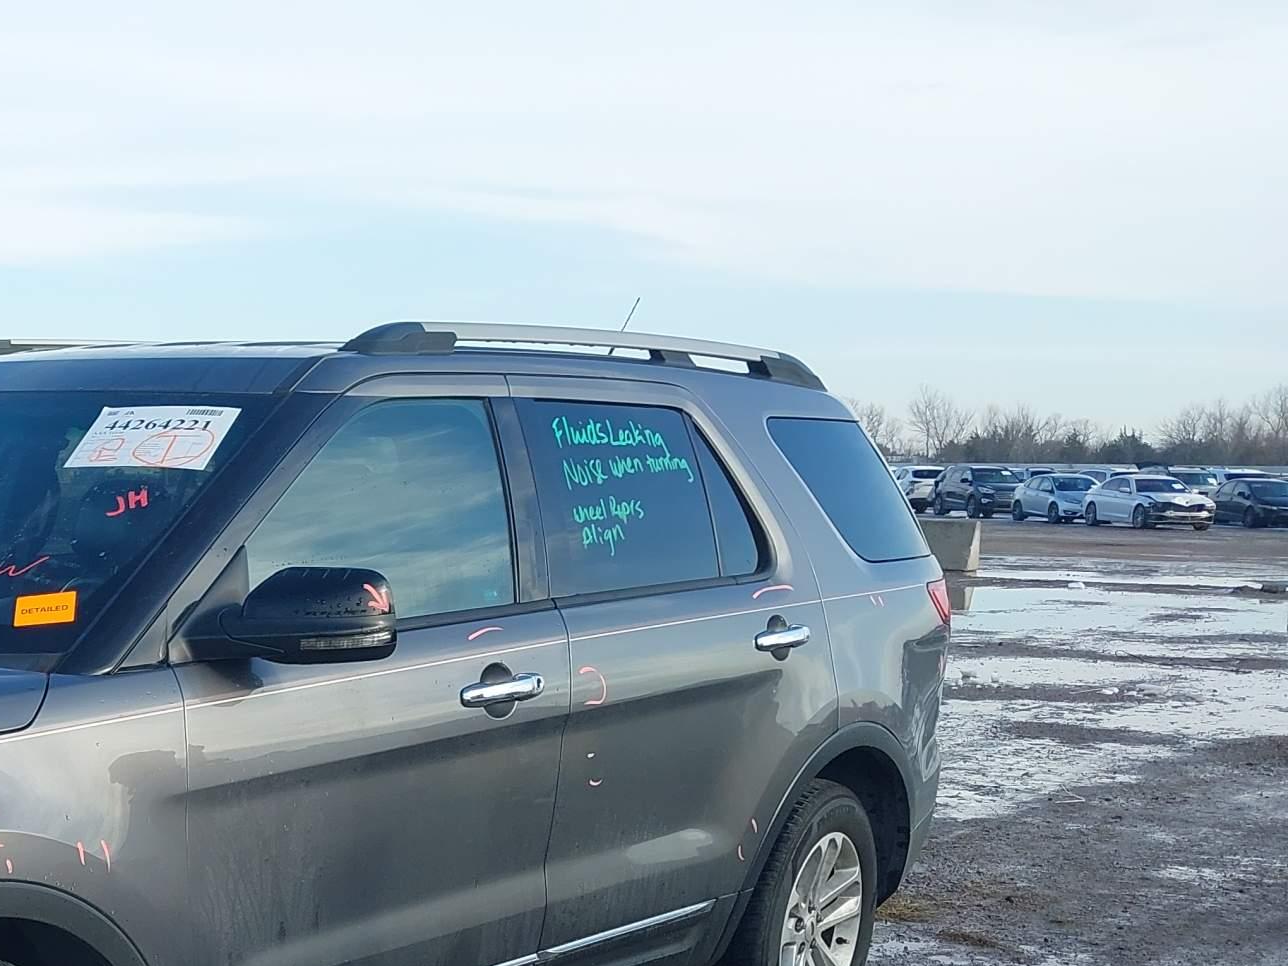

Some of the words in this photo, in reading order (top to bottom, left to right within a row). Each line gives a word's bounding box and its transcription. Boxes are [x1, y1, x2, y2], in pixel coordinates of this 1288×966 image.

[105, 418, 212, 431] 44264221
[606, 419, 670, 458] Leaking
[563, 458, 608, 490] Noise
[105, 488, 150, 516] JH
[21, 604, 69, 615] DETAILED
